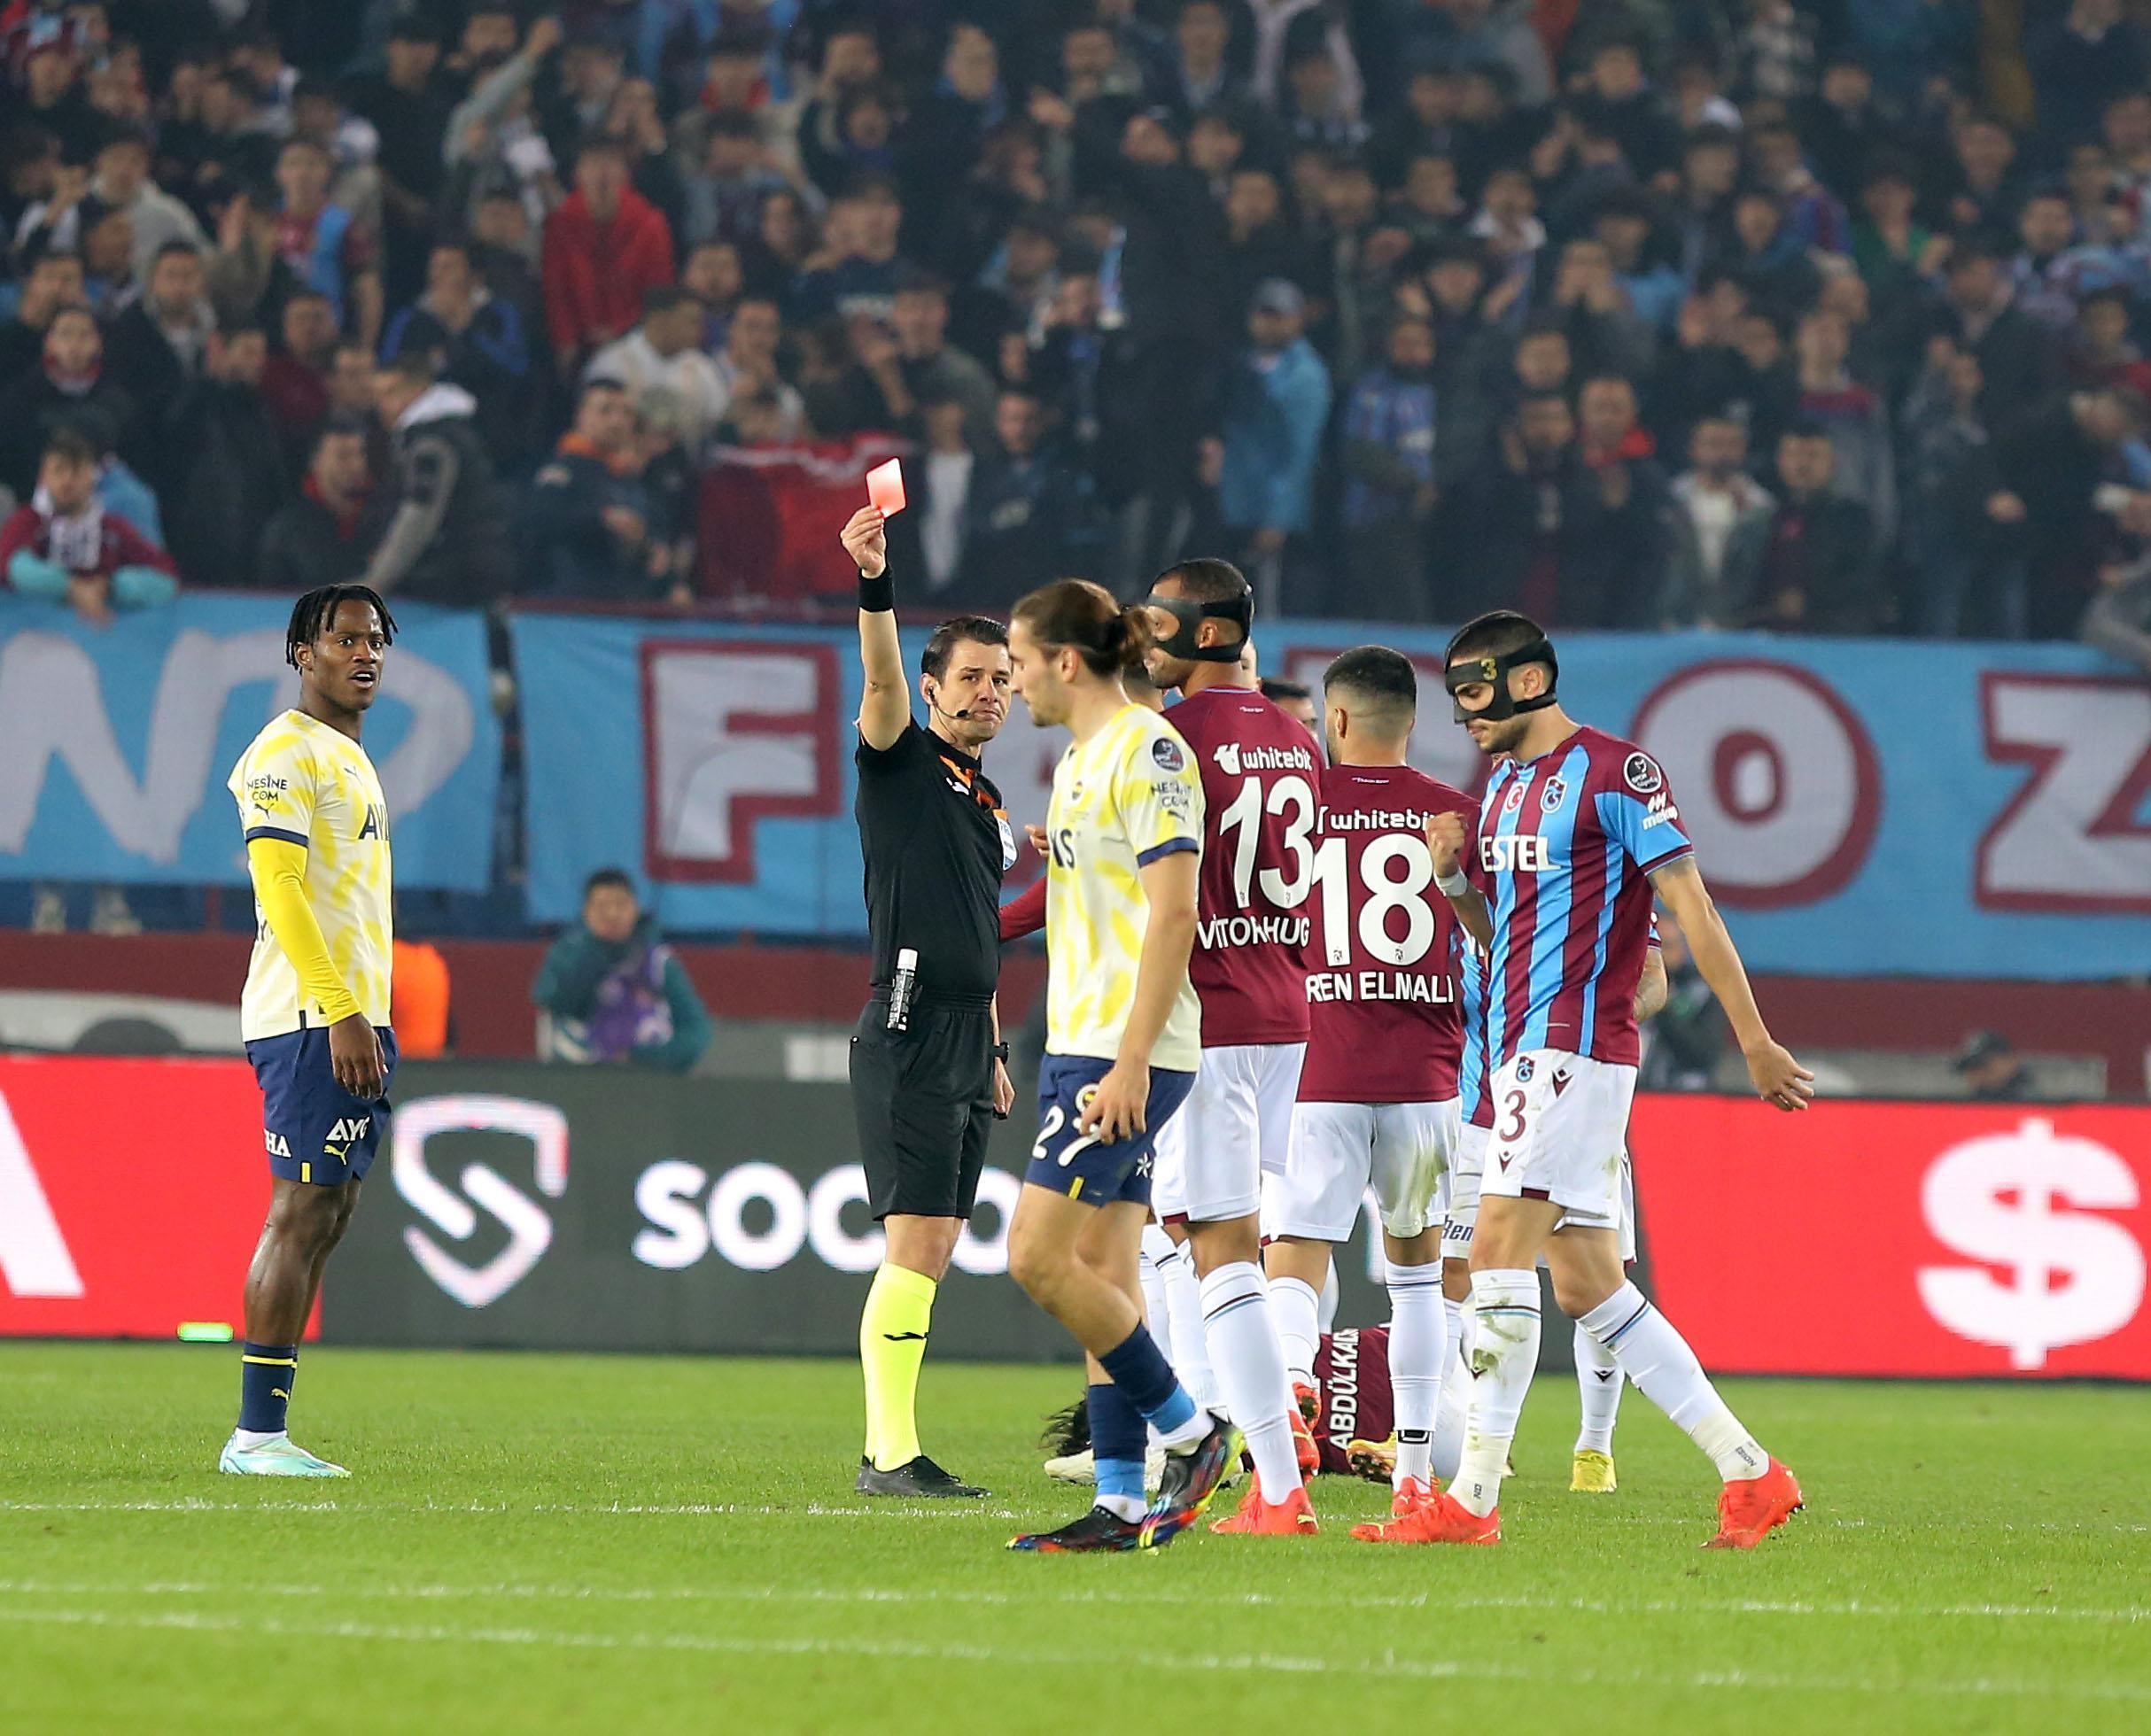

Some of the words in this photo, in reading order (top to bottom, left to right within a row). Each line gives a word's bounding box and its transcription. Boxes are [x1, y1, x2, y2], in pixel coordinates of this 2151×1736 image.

[1480, 658, 1497, 681] 3
[1219, 776, 1315, 910] 13
[1331, 809, 1433, 831] whitebi
[1480, 834, 1561, 872] ESTEL
[1312, 833, 1435, 966] 18
[1499, 1089, 1526, 1143] 3
